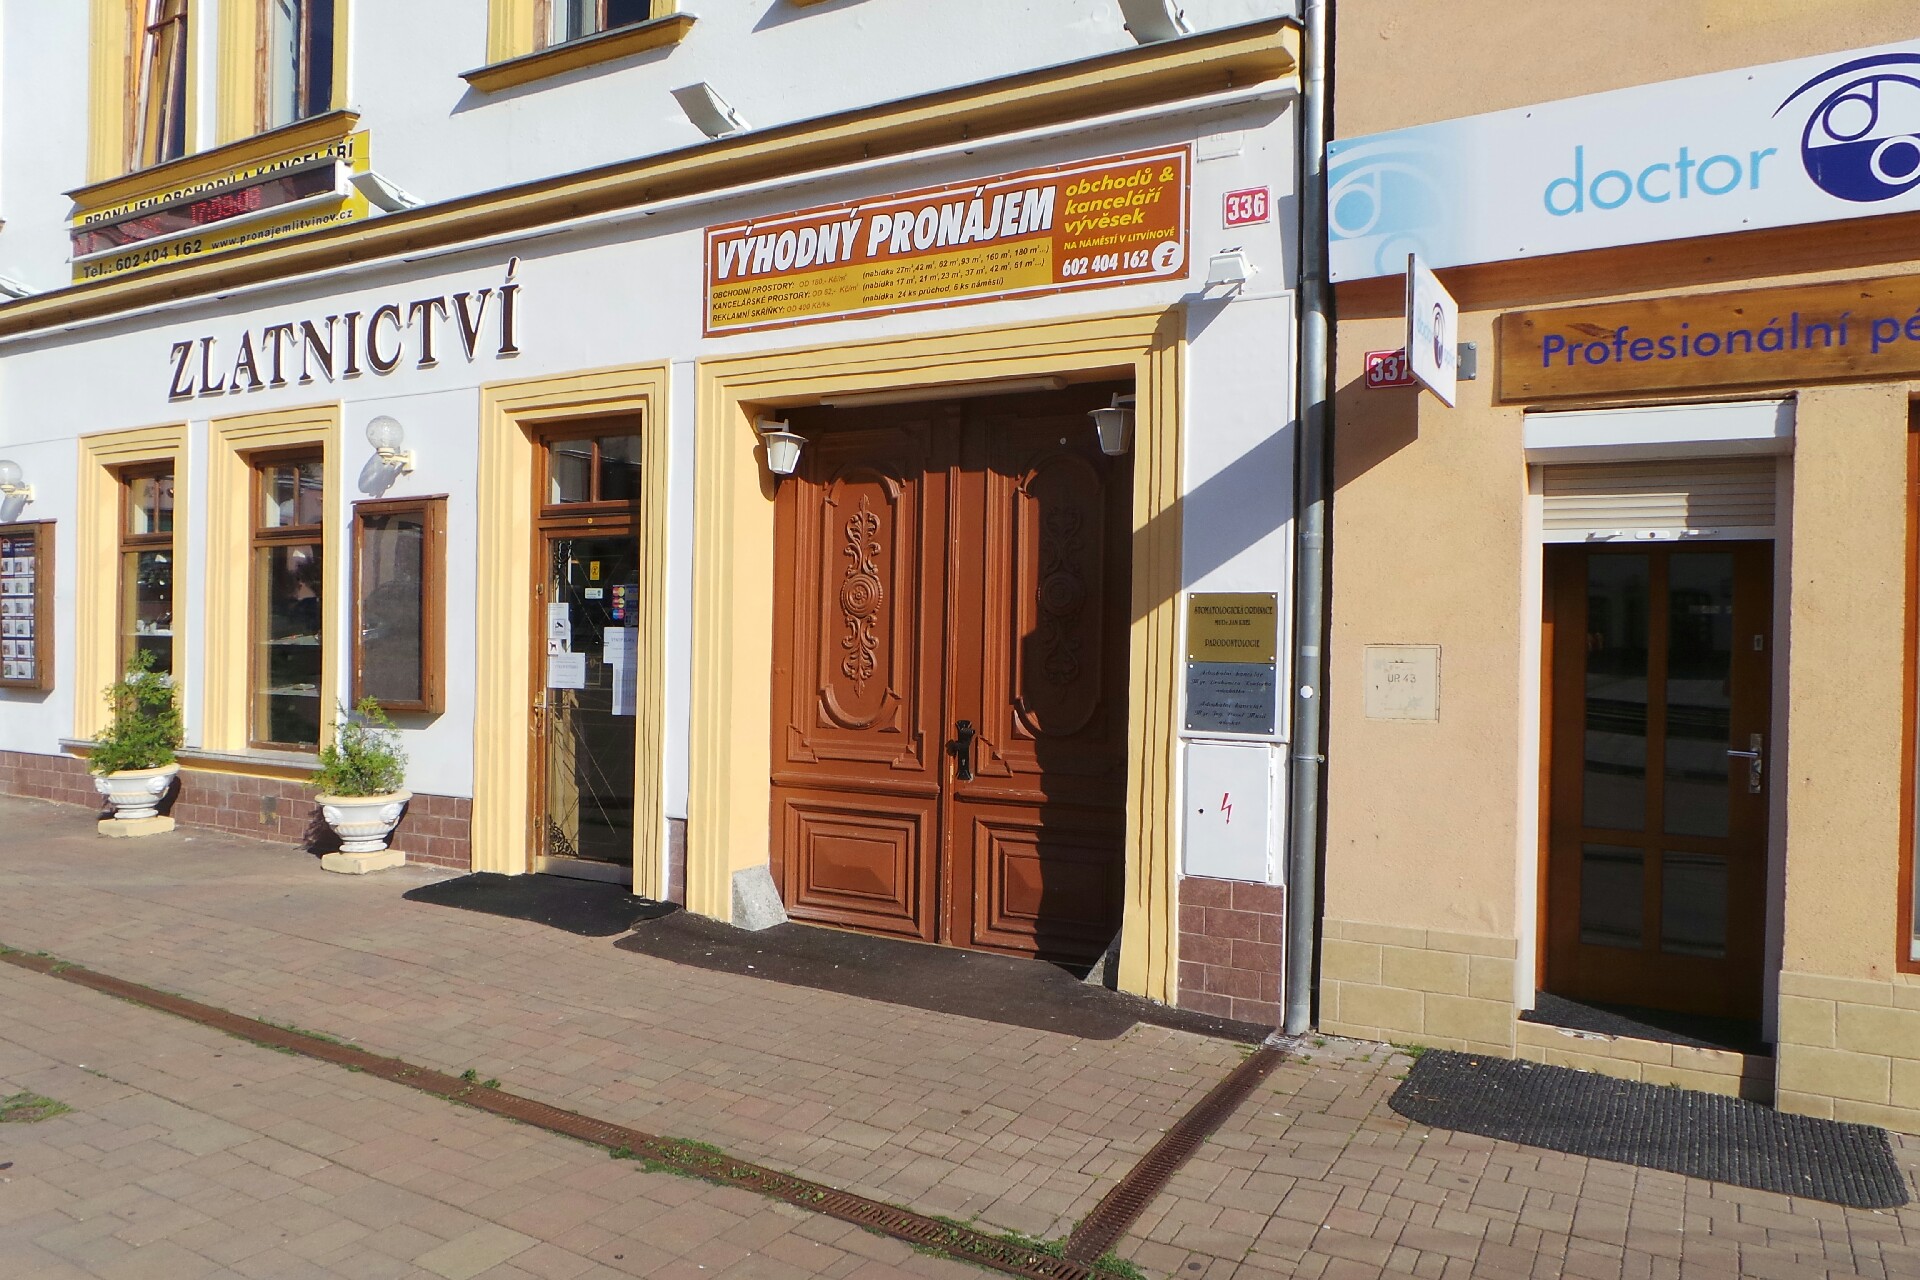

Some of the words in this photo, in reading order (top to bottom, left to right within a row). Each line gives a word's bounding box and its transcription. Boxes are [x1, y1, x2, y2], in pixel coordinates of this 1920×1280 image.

[1065, 167, 1153, 196] obchodů
[1159, 166, 1174, 182] &
[1543, 145, 1778, 216] doctor
[1064, 186, 1163, 215] kanceláří
[1227, 192, 1266, 221] 336
[717, 206, 864, 280] VÝHODNÝ
[866, 184, 1057, 257] PRONÁJEM
[1064, 208, 1145, 235] vývěsek
[115, 254, 140, 271] 602
[143, 247, 168, 263] 404
[175, 239, 202, 257] 162
[211, 209, 353, 250] www.pronajemlitvinov.cz
[1064, 242, 1077, 250] NA
[1120, 234, 1127, 243] V
[1062, 257, 1089, 277] 602
[1091, 253, 1119, 272] 404
[1123, 249, 1149, 269] 162
[751, 282, 795, 294] PROSTORY:
[768, 291, 811, 303] PROSTORY:
[167, 256, 523, 401] ZLATNICTVÍ
[1542, 312, 1853, 368] Profesionální
